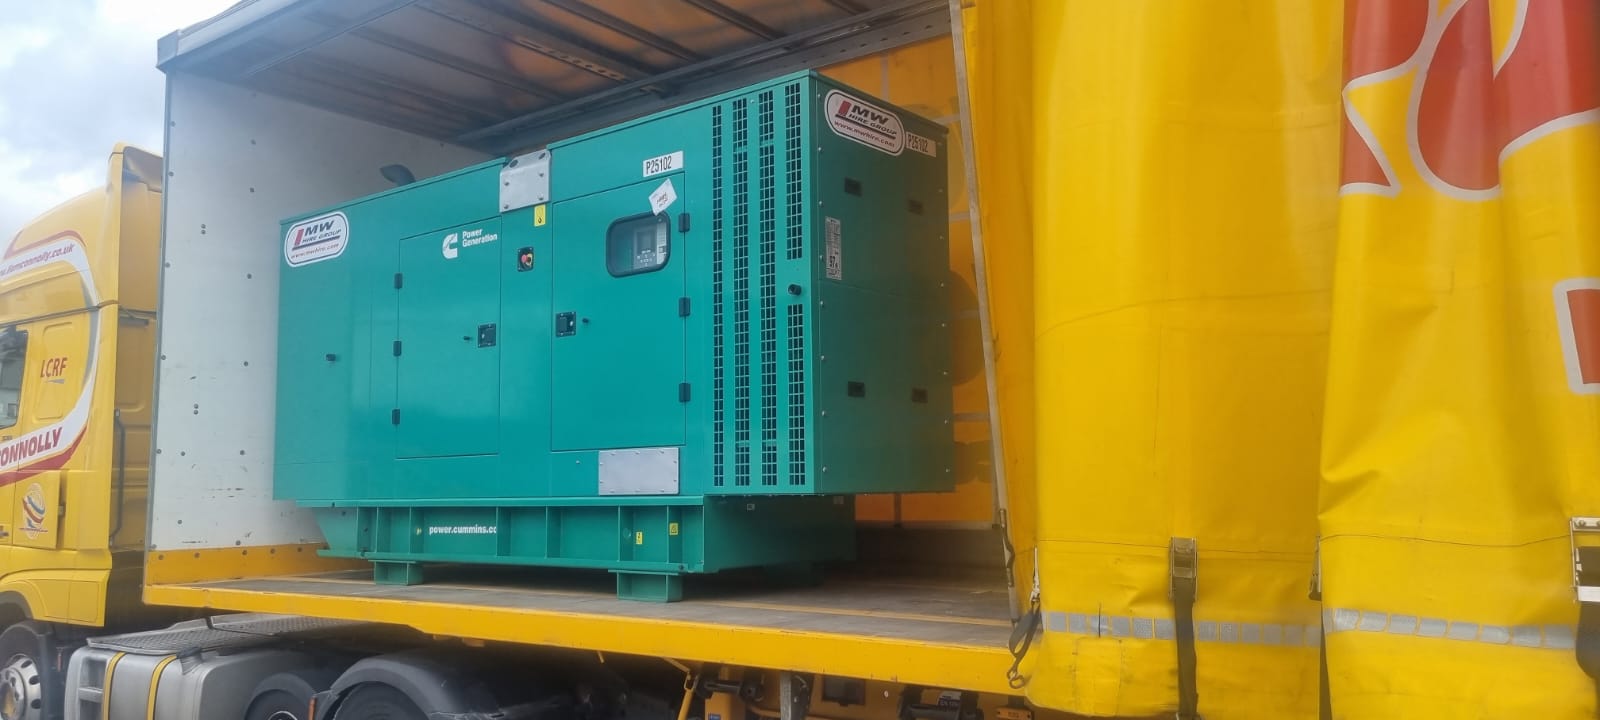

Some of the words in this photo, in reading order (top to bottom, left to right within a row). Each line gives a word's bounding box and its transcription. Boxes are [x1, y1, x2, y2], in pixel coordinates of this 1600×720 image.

[848, 113, 868, 124] HIRE
[869, 121, 898, 136] GROUP
[850, 104, 889, 126] MW
[834, 120, 896, 149] www.mwhire.com
[907, 133, 929, 153] P25102
[645, 155, 672, 175] P25102
[304, 220, 335, 237] MW
[462, 228, 483, 240] Power
[462, 233, 498, 248] Generation
[40, 357, 68, 379] LCRF
[0, 426, 63, 468] ONNOLLY
